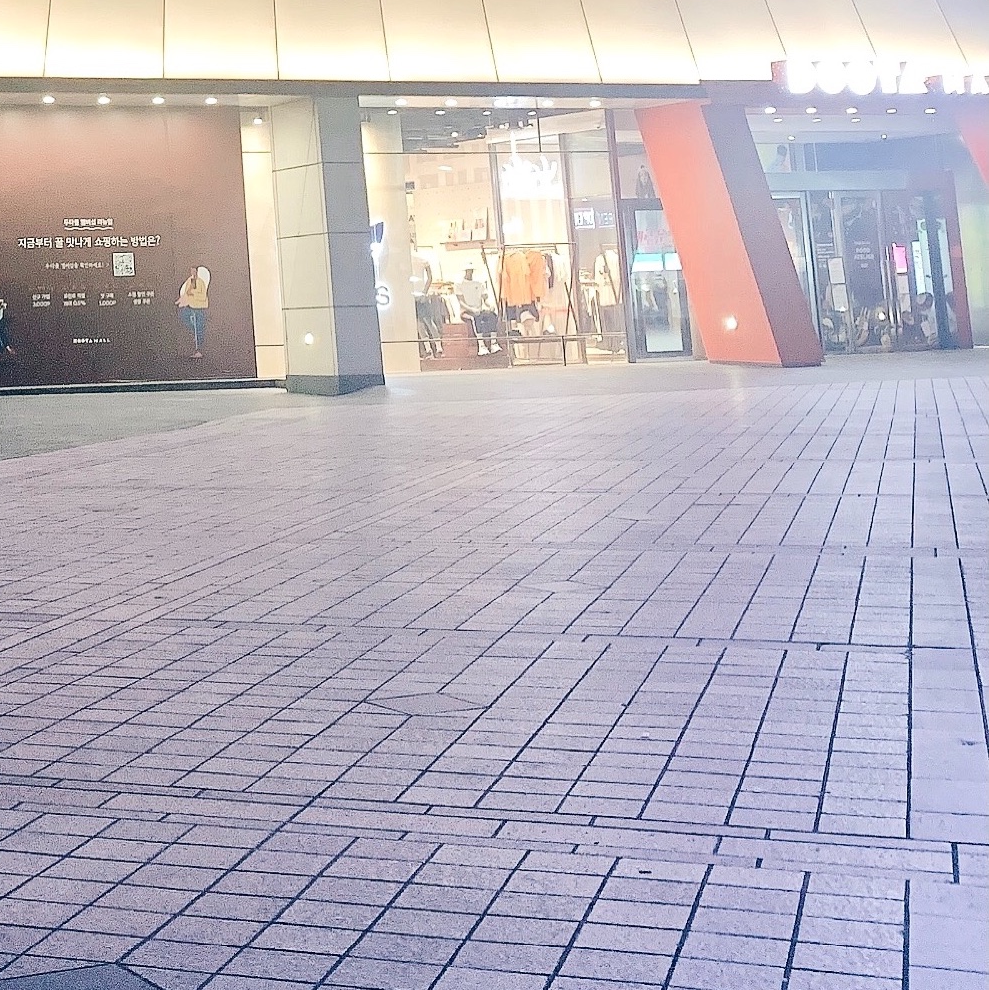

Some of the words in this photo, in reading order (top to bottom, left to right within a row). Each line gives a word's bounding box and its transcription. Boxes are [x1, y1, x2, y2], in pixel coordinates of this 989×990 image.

[17, 237, 52, 249] 지금부터
[55, 237, 64, 248] 꿀
[94, 236, 128, 247] 쇼핑하는
[130, 234, 161, 247] 방법은?
